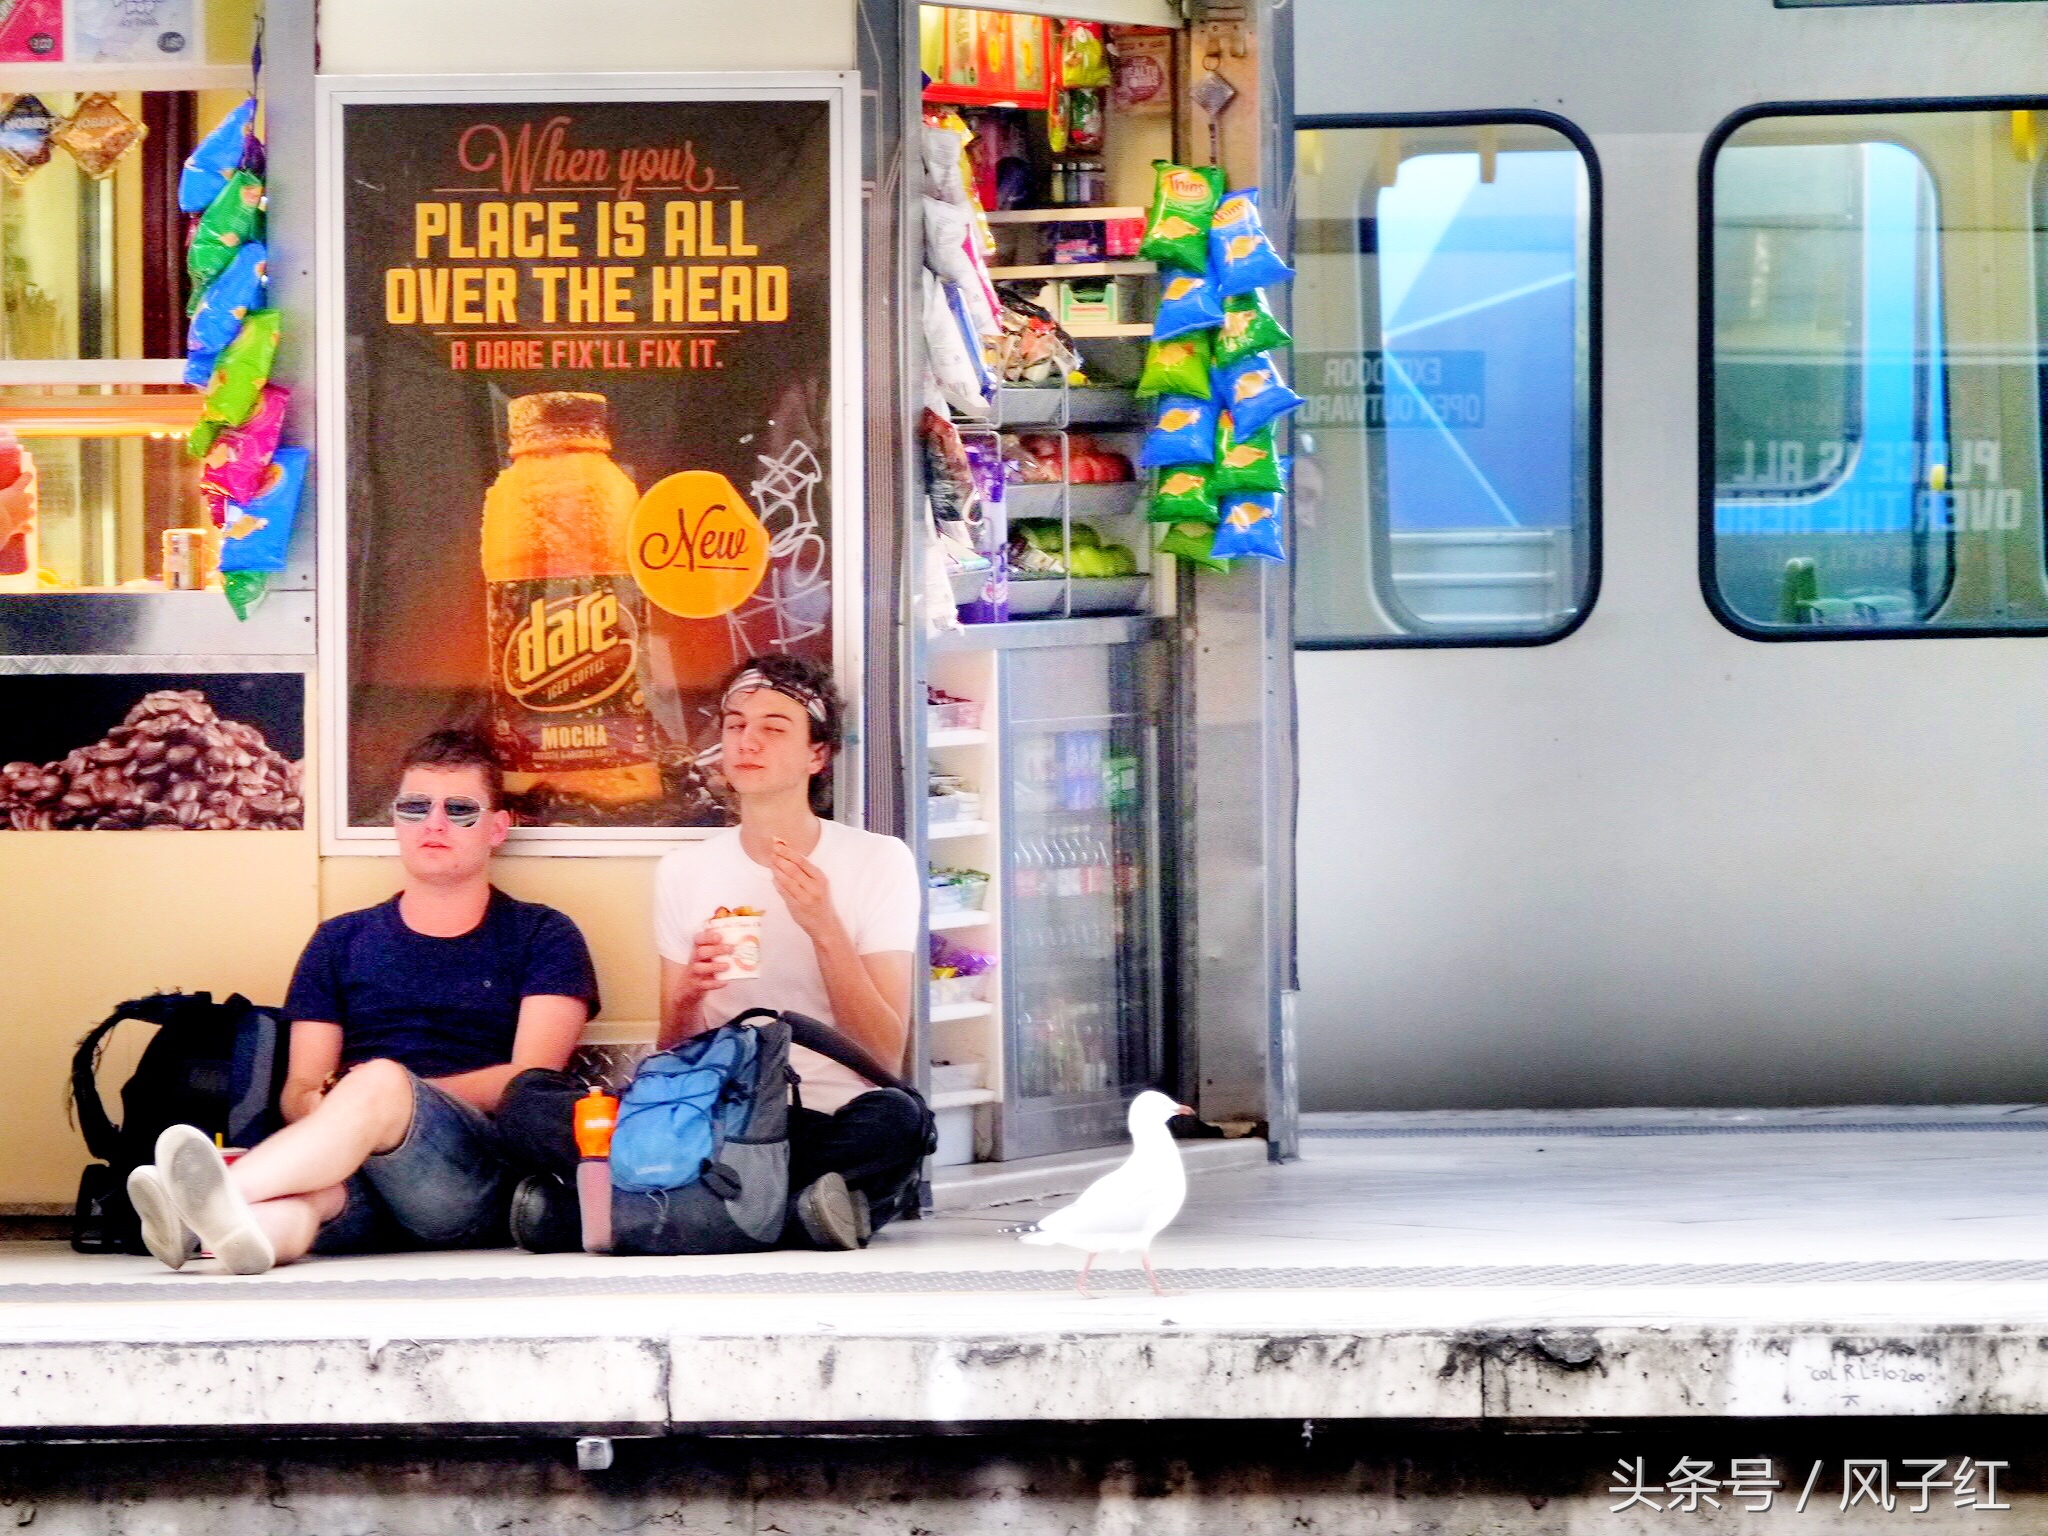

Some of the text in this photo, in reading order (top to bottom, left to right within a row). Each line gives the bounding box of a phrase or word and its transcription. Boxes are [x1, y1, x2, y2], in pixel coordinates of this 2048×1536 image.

[458, 115, 714, 198] When your
[415, 200, 758, 258] PLACE IS ALL
[385, 265, 789, 324] OVER THE HEAD
[451, 338, 724, 370] A DARE FIX'LL FIX IT.
[639, 503, 748, 572] New
[518, 589, 619, 684] dare
[541, 724, 608, 751] MOCHA
